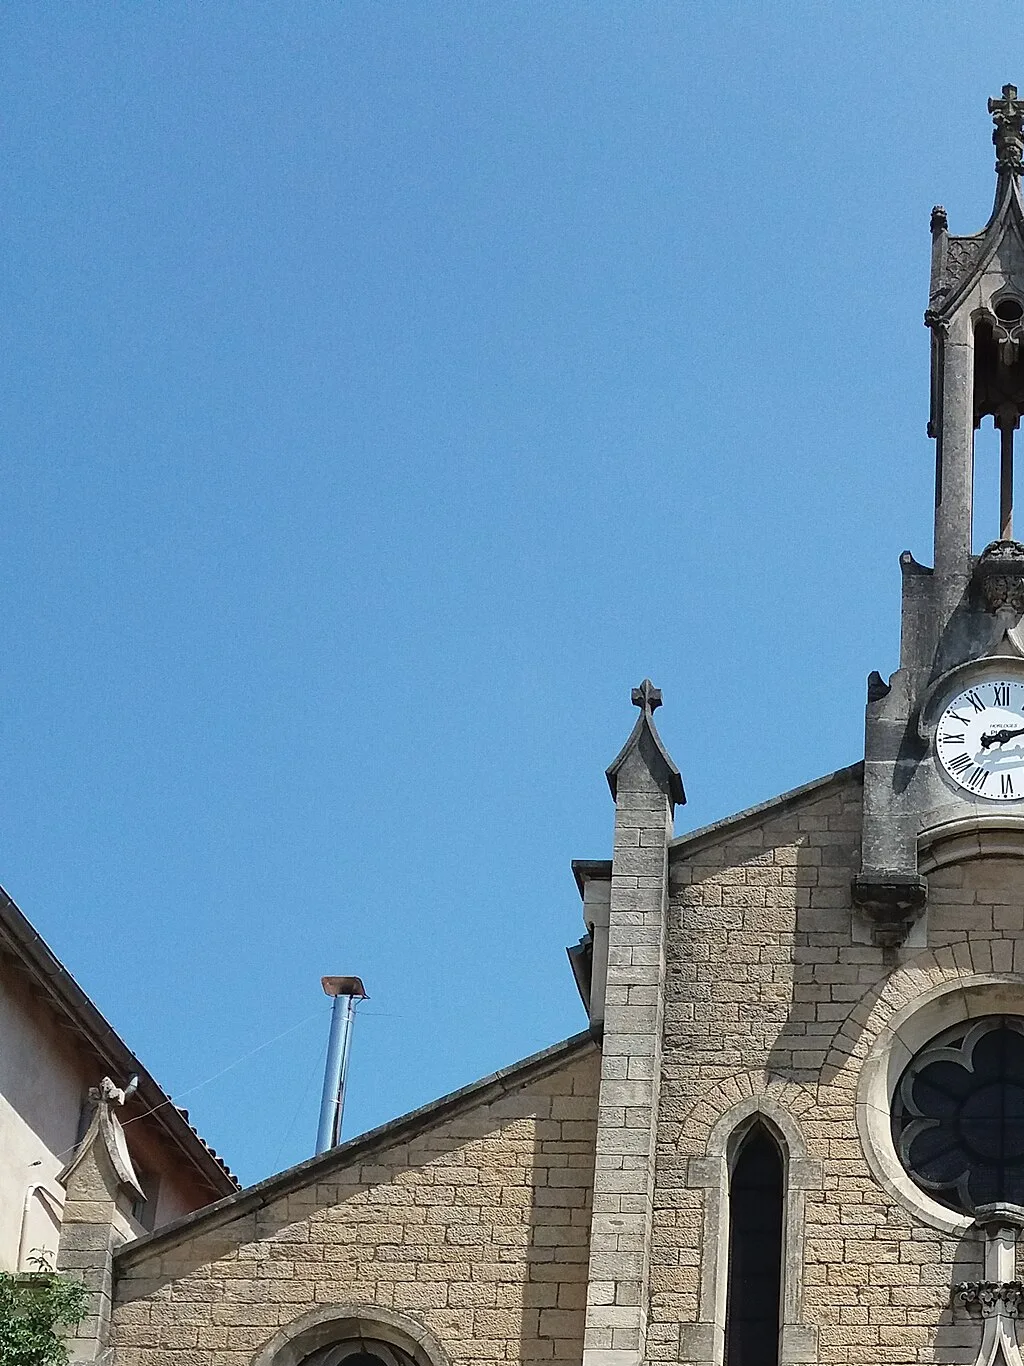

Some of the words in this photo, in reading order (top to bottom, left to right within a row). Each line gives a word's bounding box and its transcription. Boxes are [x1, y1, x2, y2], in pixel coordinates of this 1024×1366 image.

[965, 692, 986, 714] XI
[993, 686, 1010, 706] XII
[949, 711, 971, 726] X
[943, 733, 965, 743] IX
[948, 752, 974, 775] VIII
[968, 766, 990, 790] VII
[1001, 774, 1014, 794] VI
